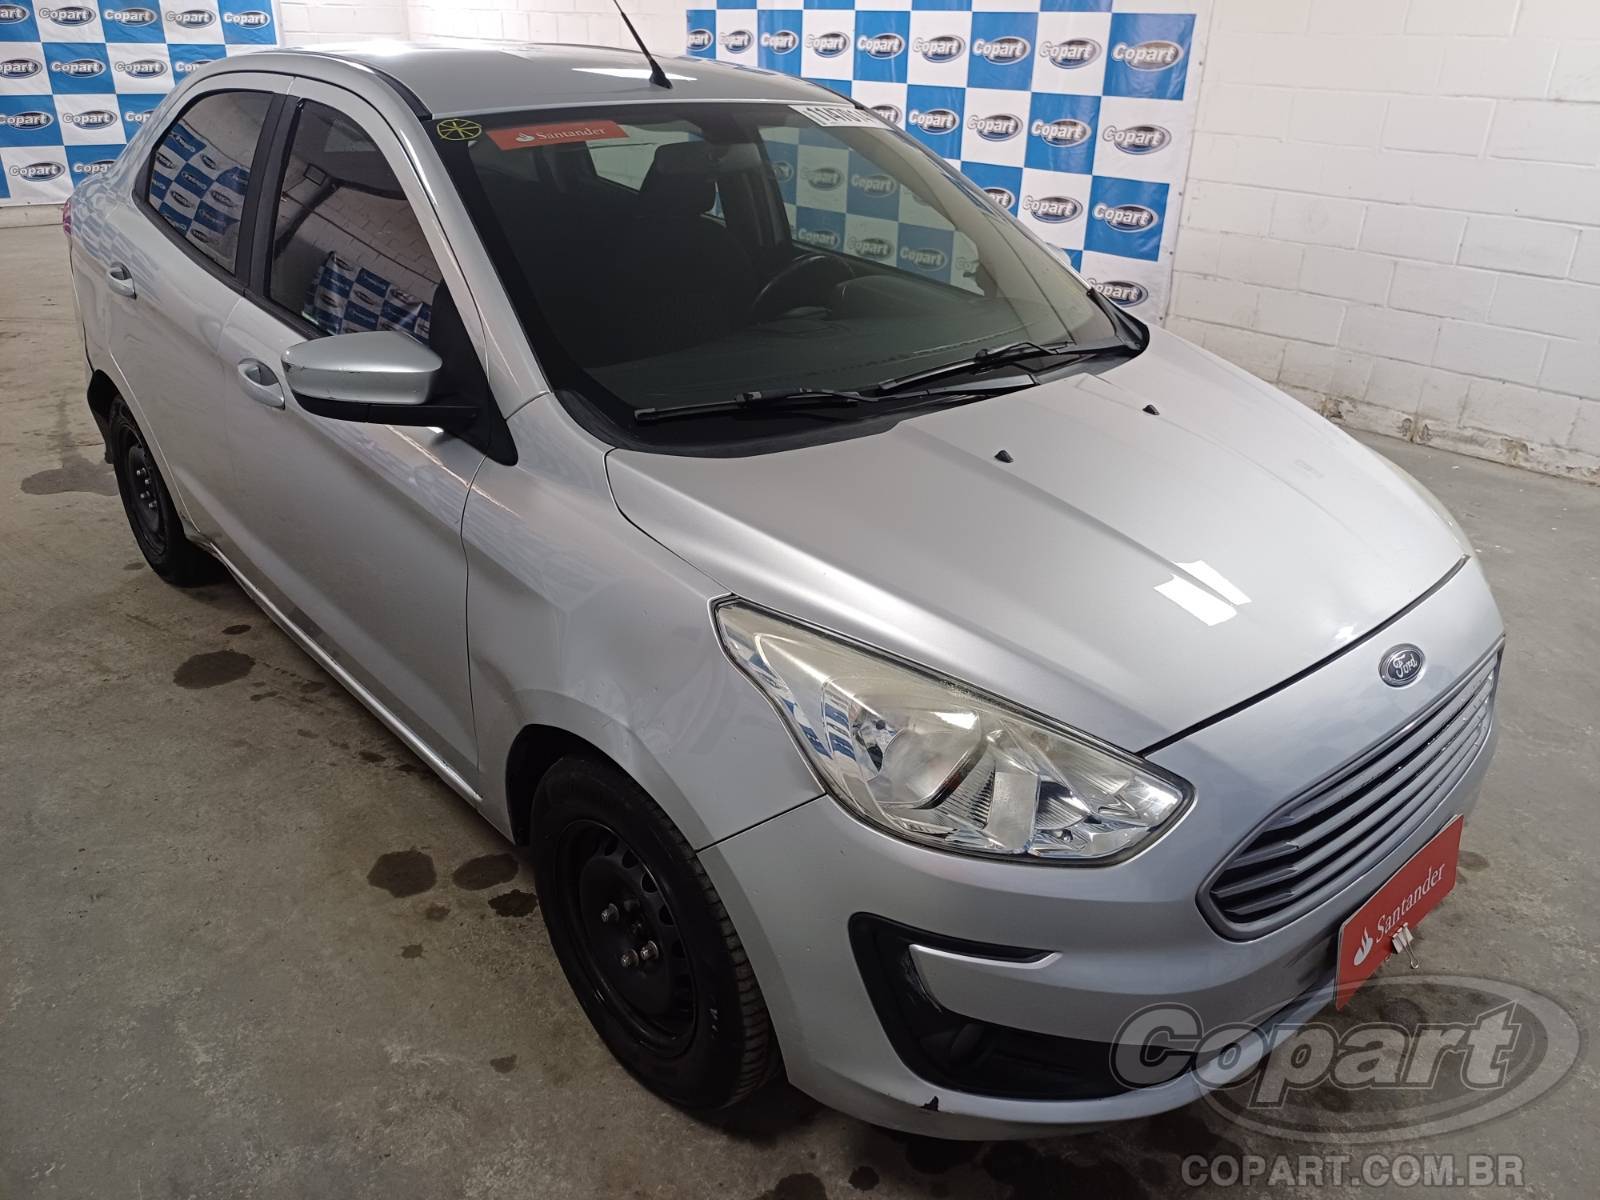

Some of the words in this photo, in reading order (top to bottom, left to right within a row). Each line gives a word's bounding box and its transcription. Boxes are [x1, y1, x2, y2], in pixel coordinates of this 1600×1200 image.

[40, 8, 88, 21] Copart
[104, 9, 150, 22] Copart
[166, 11, 209, 24] Copart
[223, 12, 265, 25] Copart
[761, 34, 795, 49] Copart
[805, 35, 846, 51] Copart
[857, 35, 899, 53] Copart
[913, 37, 958, 55] Copart
[973, 39, 1024, 58] Copart
[1039, 41, 1091, 61] Copart
[1112, 43, 1175, 63] Copart
[51, 62, 99, 75] Copart
[115, 62, 160, 75] Copart
[63, 112, 110, 125] Copart
[909, 110, 953, 128] Copart
[967, 114, 1016, 135] Copart
[536, 127, 606, 140] Santander
[1031, 119, 1083, 141] Copart
[1103, 126, 1161, 148] Copart
[9, 164, 57, 178] Copart
[851, 174, 891, 192] Copart
[1023, 196, 1073, 217] Copart
[1093, 204, 1150, 226] Copart
[900, 246, 942, 266] Copart
[1392, 653, 1418, 678] Ford
[1376, 863, 1446, 943] Santander
